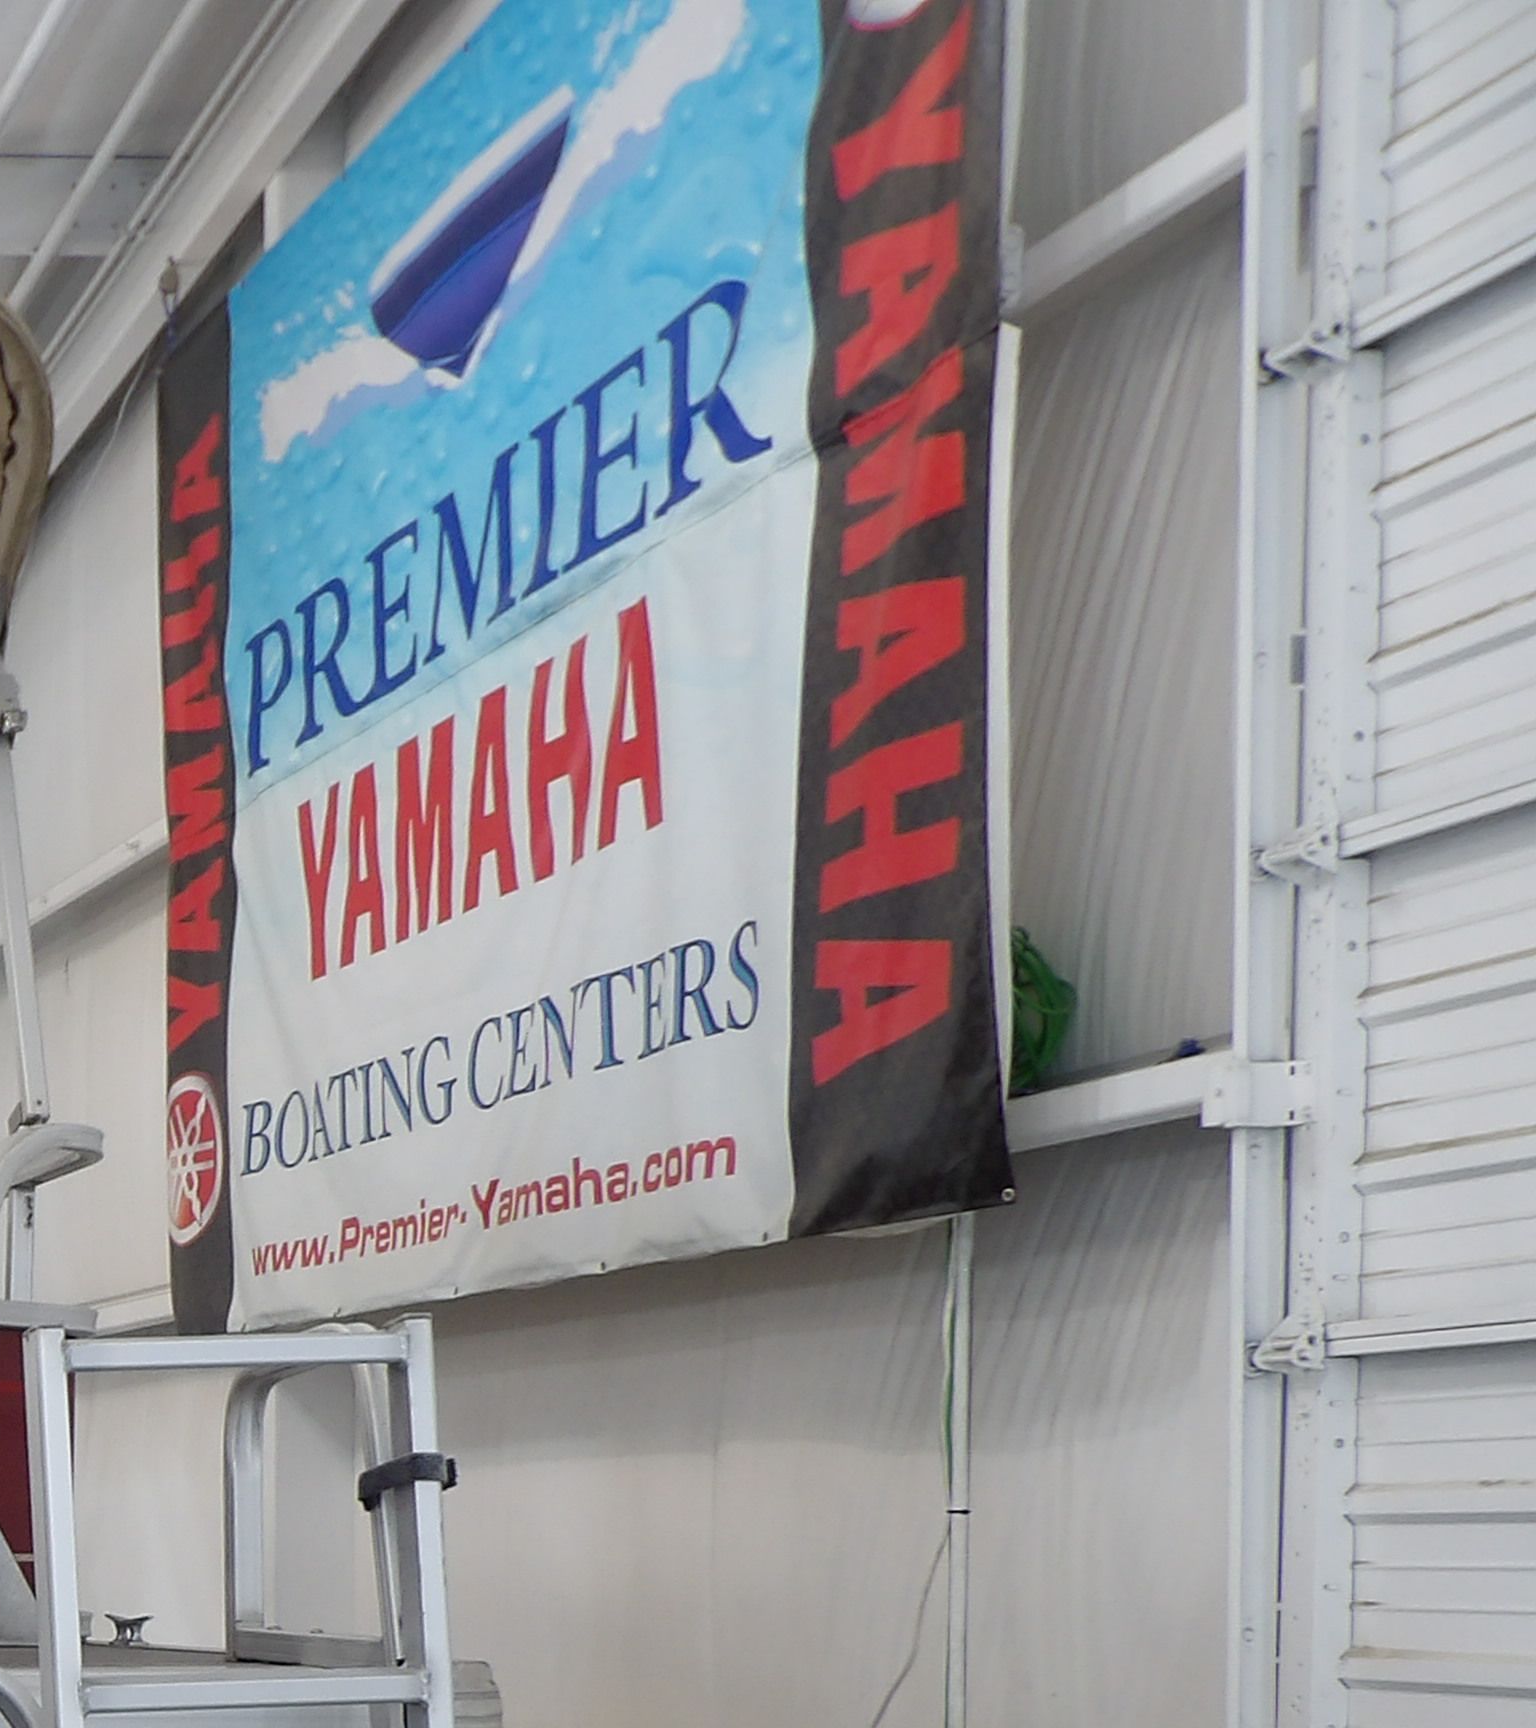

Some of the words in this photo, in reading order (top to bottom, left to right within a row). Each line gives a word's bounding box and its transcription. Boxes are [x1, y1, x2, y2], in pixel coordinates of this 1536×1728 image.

[244, 279, 772, 777] PREMIER
[812, 2, 971, 1087] YAMAHA
[297, 595, 665, 981] YAMAHA
[239, 1035, 457, 1176] BOATING
[467, 920, 760, 1110] CENTERS
